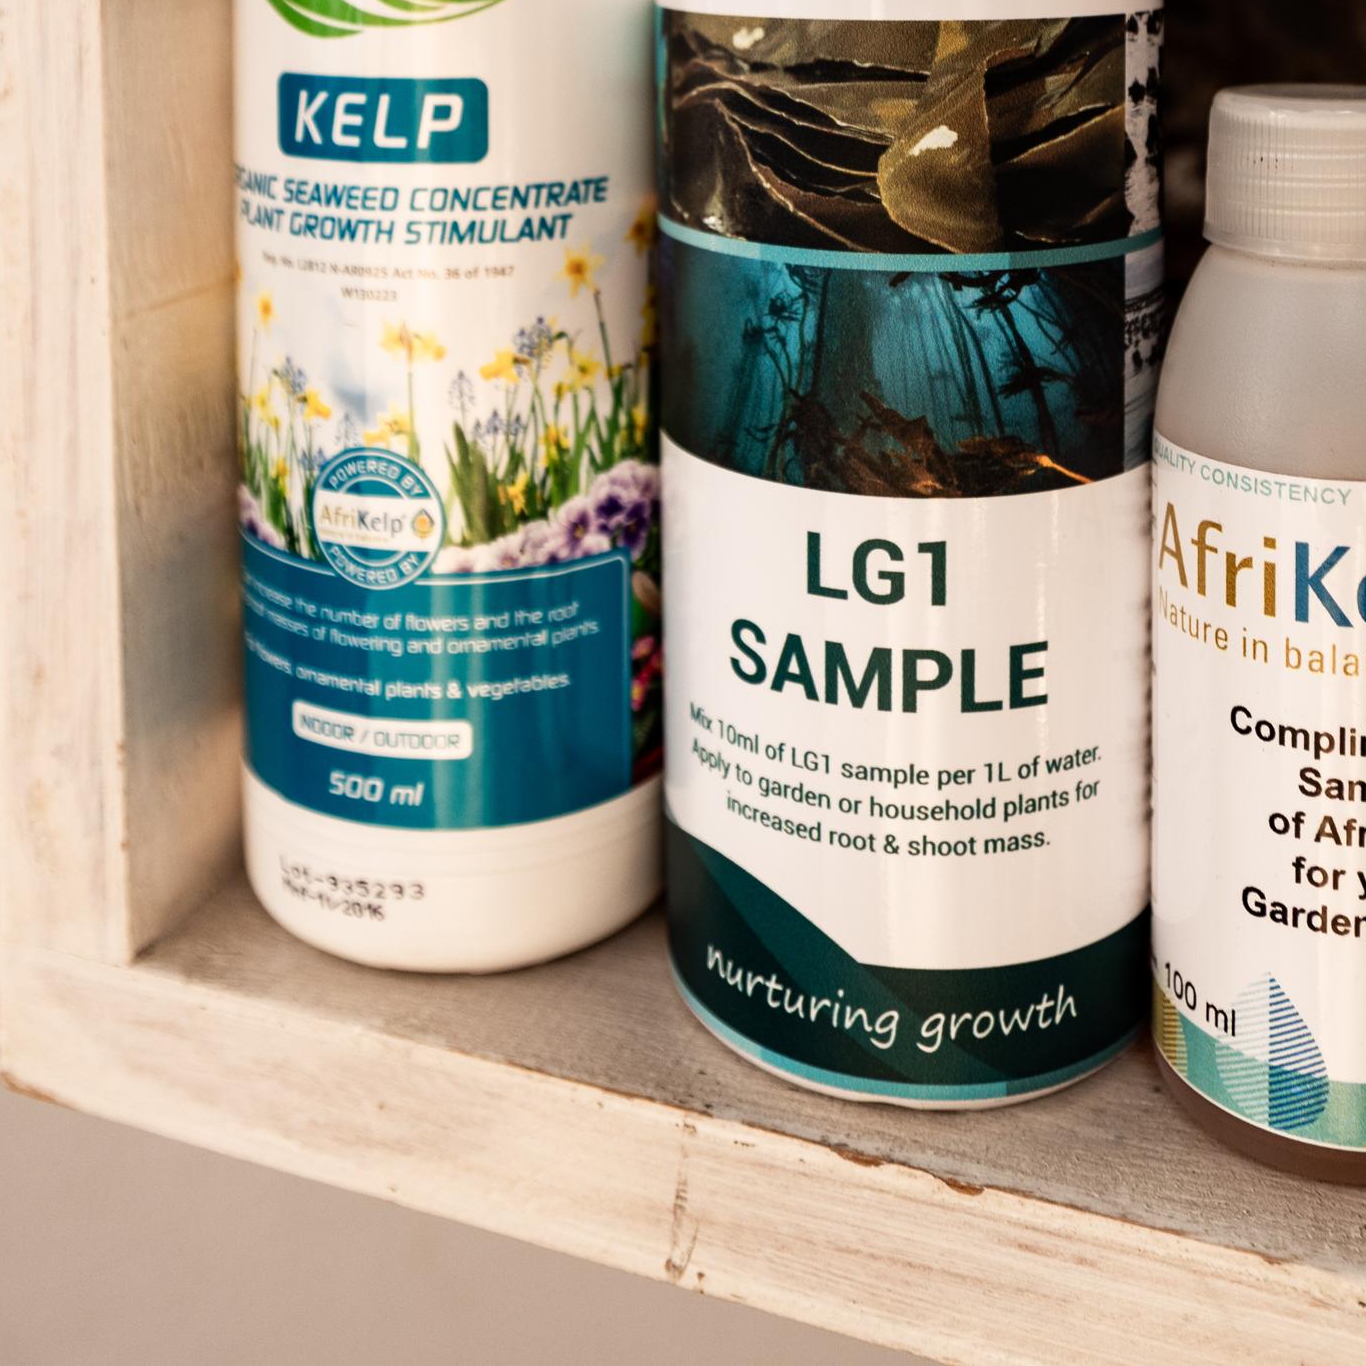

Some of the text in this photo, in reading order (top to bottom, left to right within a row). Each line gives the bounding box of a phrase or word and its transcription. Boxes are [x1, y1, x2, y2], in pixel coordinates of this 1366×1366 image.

[294, 88, 464, 149] KELP
[282, 177, 400, 213] SEAWEED
[409, 175, 610, 213] CONCENTRATE
[241, 197, 574, 246] PLANT GROWTH STIMULANT
[464, 265, 480, 280] of
[328, 458, 424, 496] POWERED BY
[1200, 464, 1352, 506] CONSISTENCY
[398, 552, 421, 575] BY
[806, 530, 947, 608] LG1
[320, 606, 380, 630] number
[383, 613, 402, 630] of
[405, 613, 470, 632] flowers
[473, 612, 510, 631] and
[514, 609, 544, 627] the
[548, 601, 580, 623] root
[1158, 585, 1229, 652] Nature
[1241, 626, 1269, 665] in
[312, 625, 327, 642] of
[330, 627, 403, 657] flowering
[407, 638, 444, 655] and
[446, 629, 549, 654] ornamental
[551, 620, 600, 646] plants
[295, 664, 382, 696] ornamental
[385, 679, 443, 701] plants
[446, 681, 463, 700] &
[466, 672, 571, 701] vegetables
[729, 617, 1049, 714] SAMPLE
[373, 729, 461, 751] OUTDOOR
[689, 700, 1103, 791] Mix 10ml of LG1 sample per 1L of water.
[328, 769, 426, 807] 500 ml
[691, 736, 1101, 823] Apply to garden or household plants for
[726, 789, 1052, 857] increased root & shoot mass.
[1267, 810, 1306, 839] of
[1291, 855, 1347, 891] for
[706, 943, 1078, 1054] nurturing growth
[1164, 960, 1236, 1038] 100 ml
